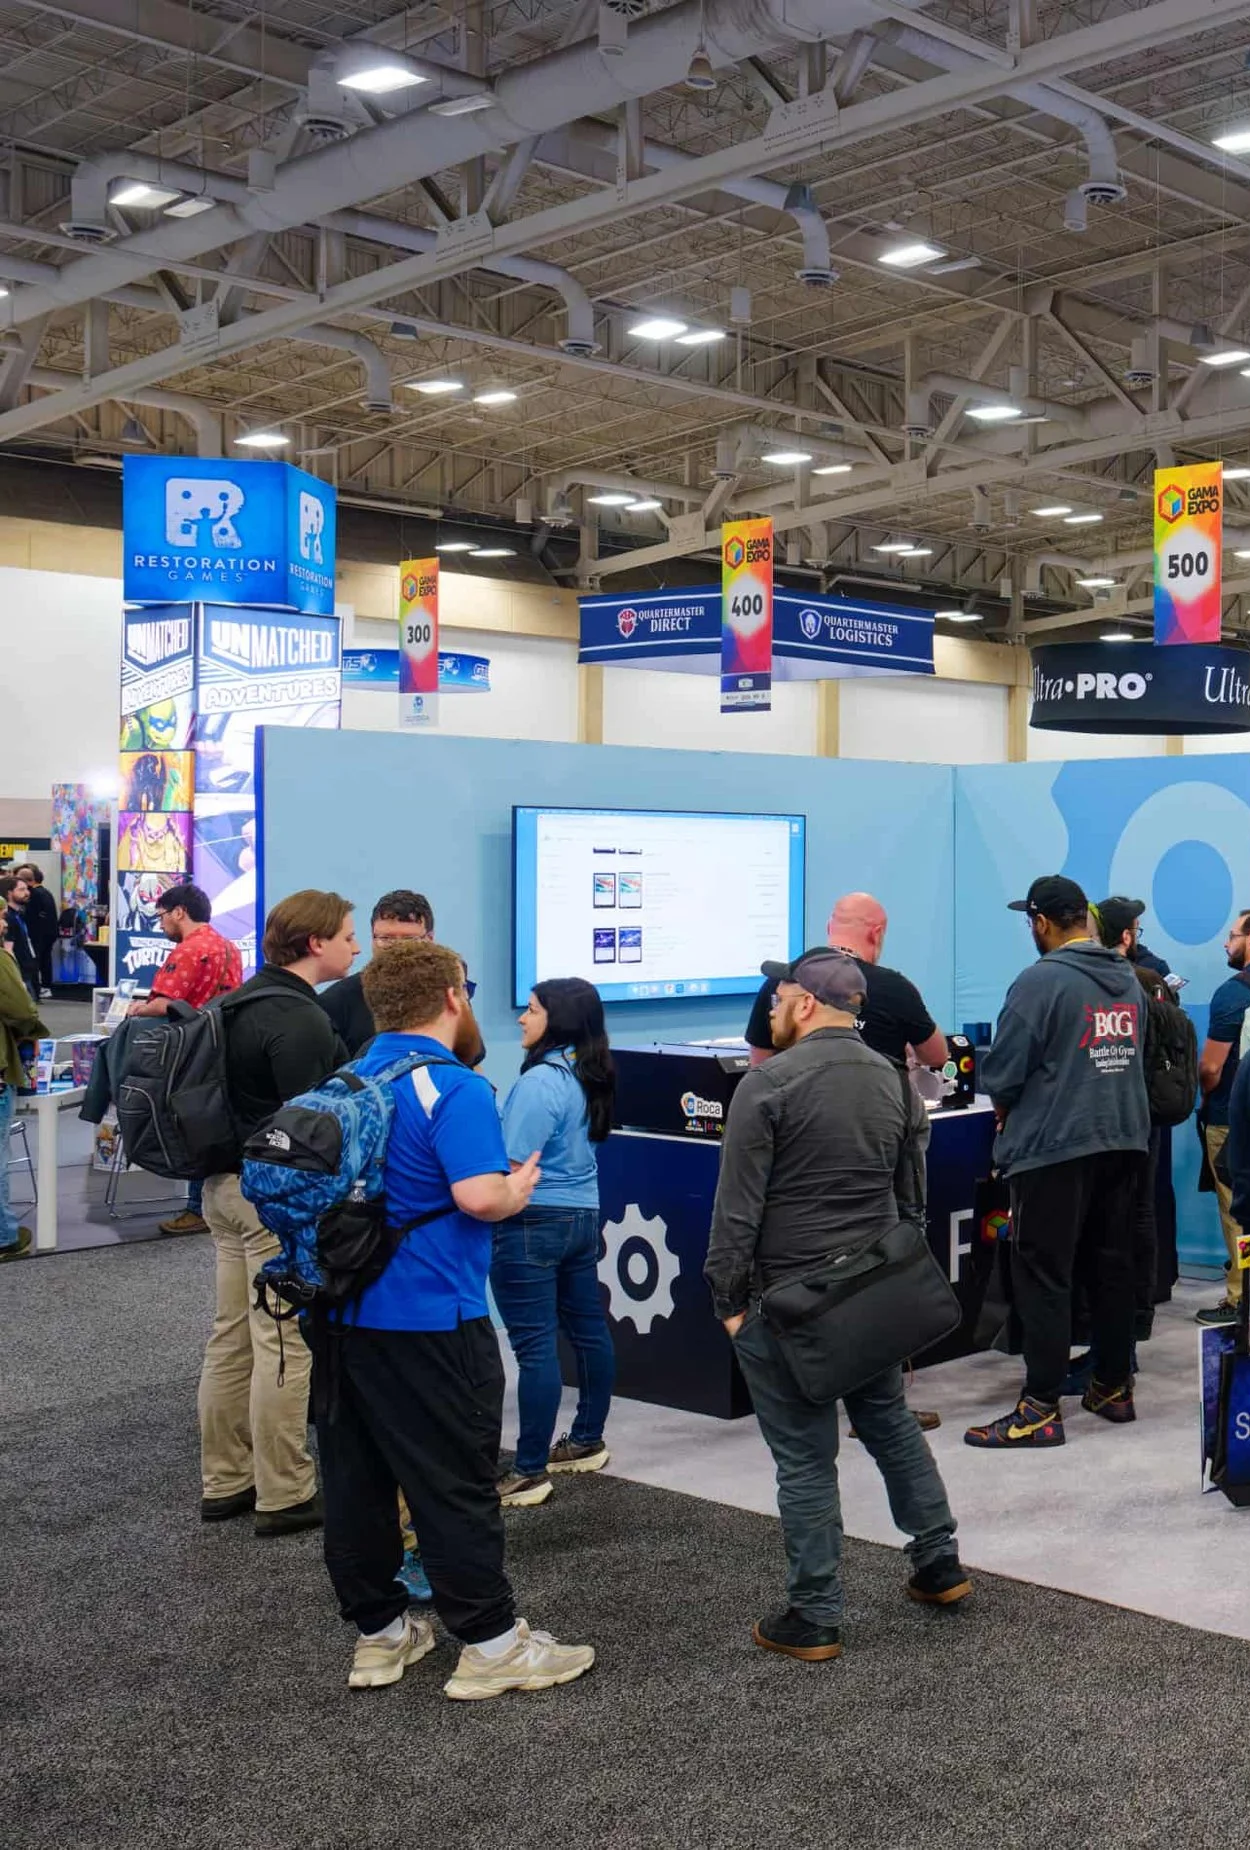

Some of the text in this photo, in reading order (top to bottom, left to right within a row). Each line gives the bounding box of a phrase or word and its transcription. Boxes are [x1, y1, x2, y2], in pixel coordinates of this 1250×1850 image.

[1188, 486, 1219, 500] GAMA
[1188, 499, 1220, 515] EXPO
[746, 538, 771, 551] GAMA
[134, 555, 276, 571] RESTORATION
[746, 550, 771, 563] EXPO
[1168, 551, 1208, 578] 500
[168, 570, 243, 582] GAMES
[289, 562, 333, 589] RESTORATION
[638, 606, 705, 620] QUARTERMASTER
[731, 595, 763, 616] 400
[407, 624, 431, 644] 300
[650, 617, 691, 633] DIRECT
[823, 615, 899, 635] QUARTERMASTER
[127, 619, 190, 666] UNMATCHED
[211, 620, 333, 668] UNMATCHED
[829, 627, 893, 647] LOGISTICS
[205, 677, 338, 709] ADVENTURES
[697, 1101, 720, 1115] Roca
